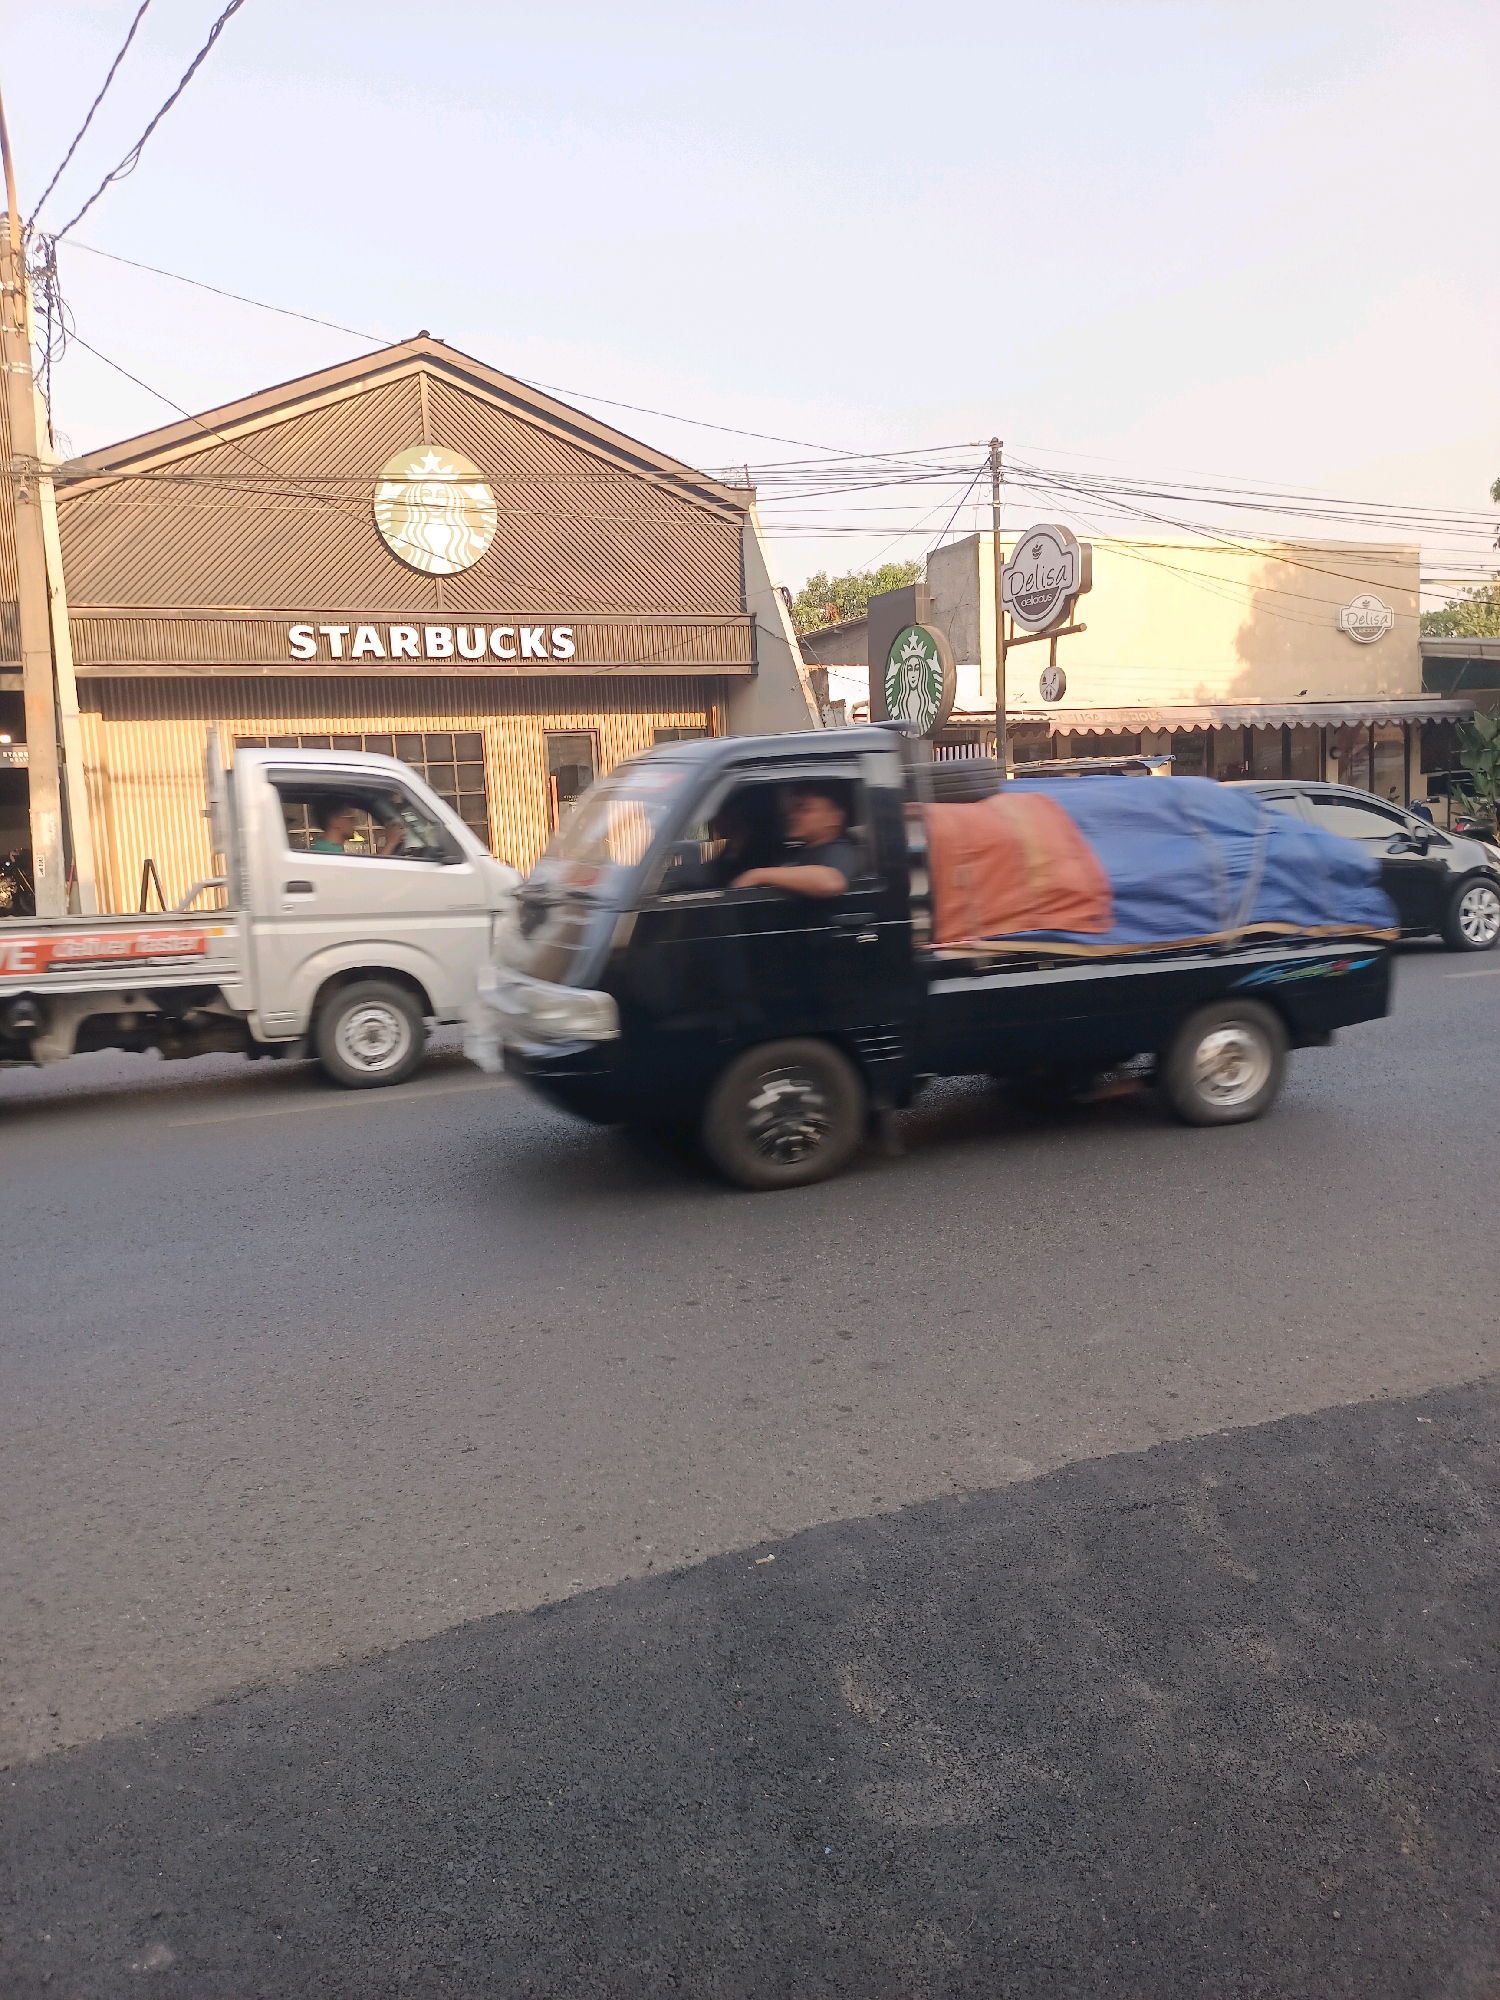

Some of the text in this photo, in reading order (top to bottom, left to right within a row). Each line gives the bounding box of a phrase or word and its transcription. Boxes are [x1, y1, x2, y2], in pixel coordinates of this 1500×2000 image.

[1007, 563, 1068, 596] Delisa
[1345, 611, 1389, 626] Delisa
[288, 623, 576, 660] STARBUCKS
